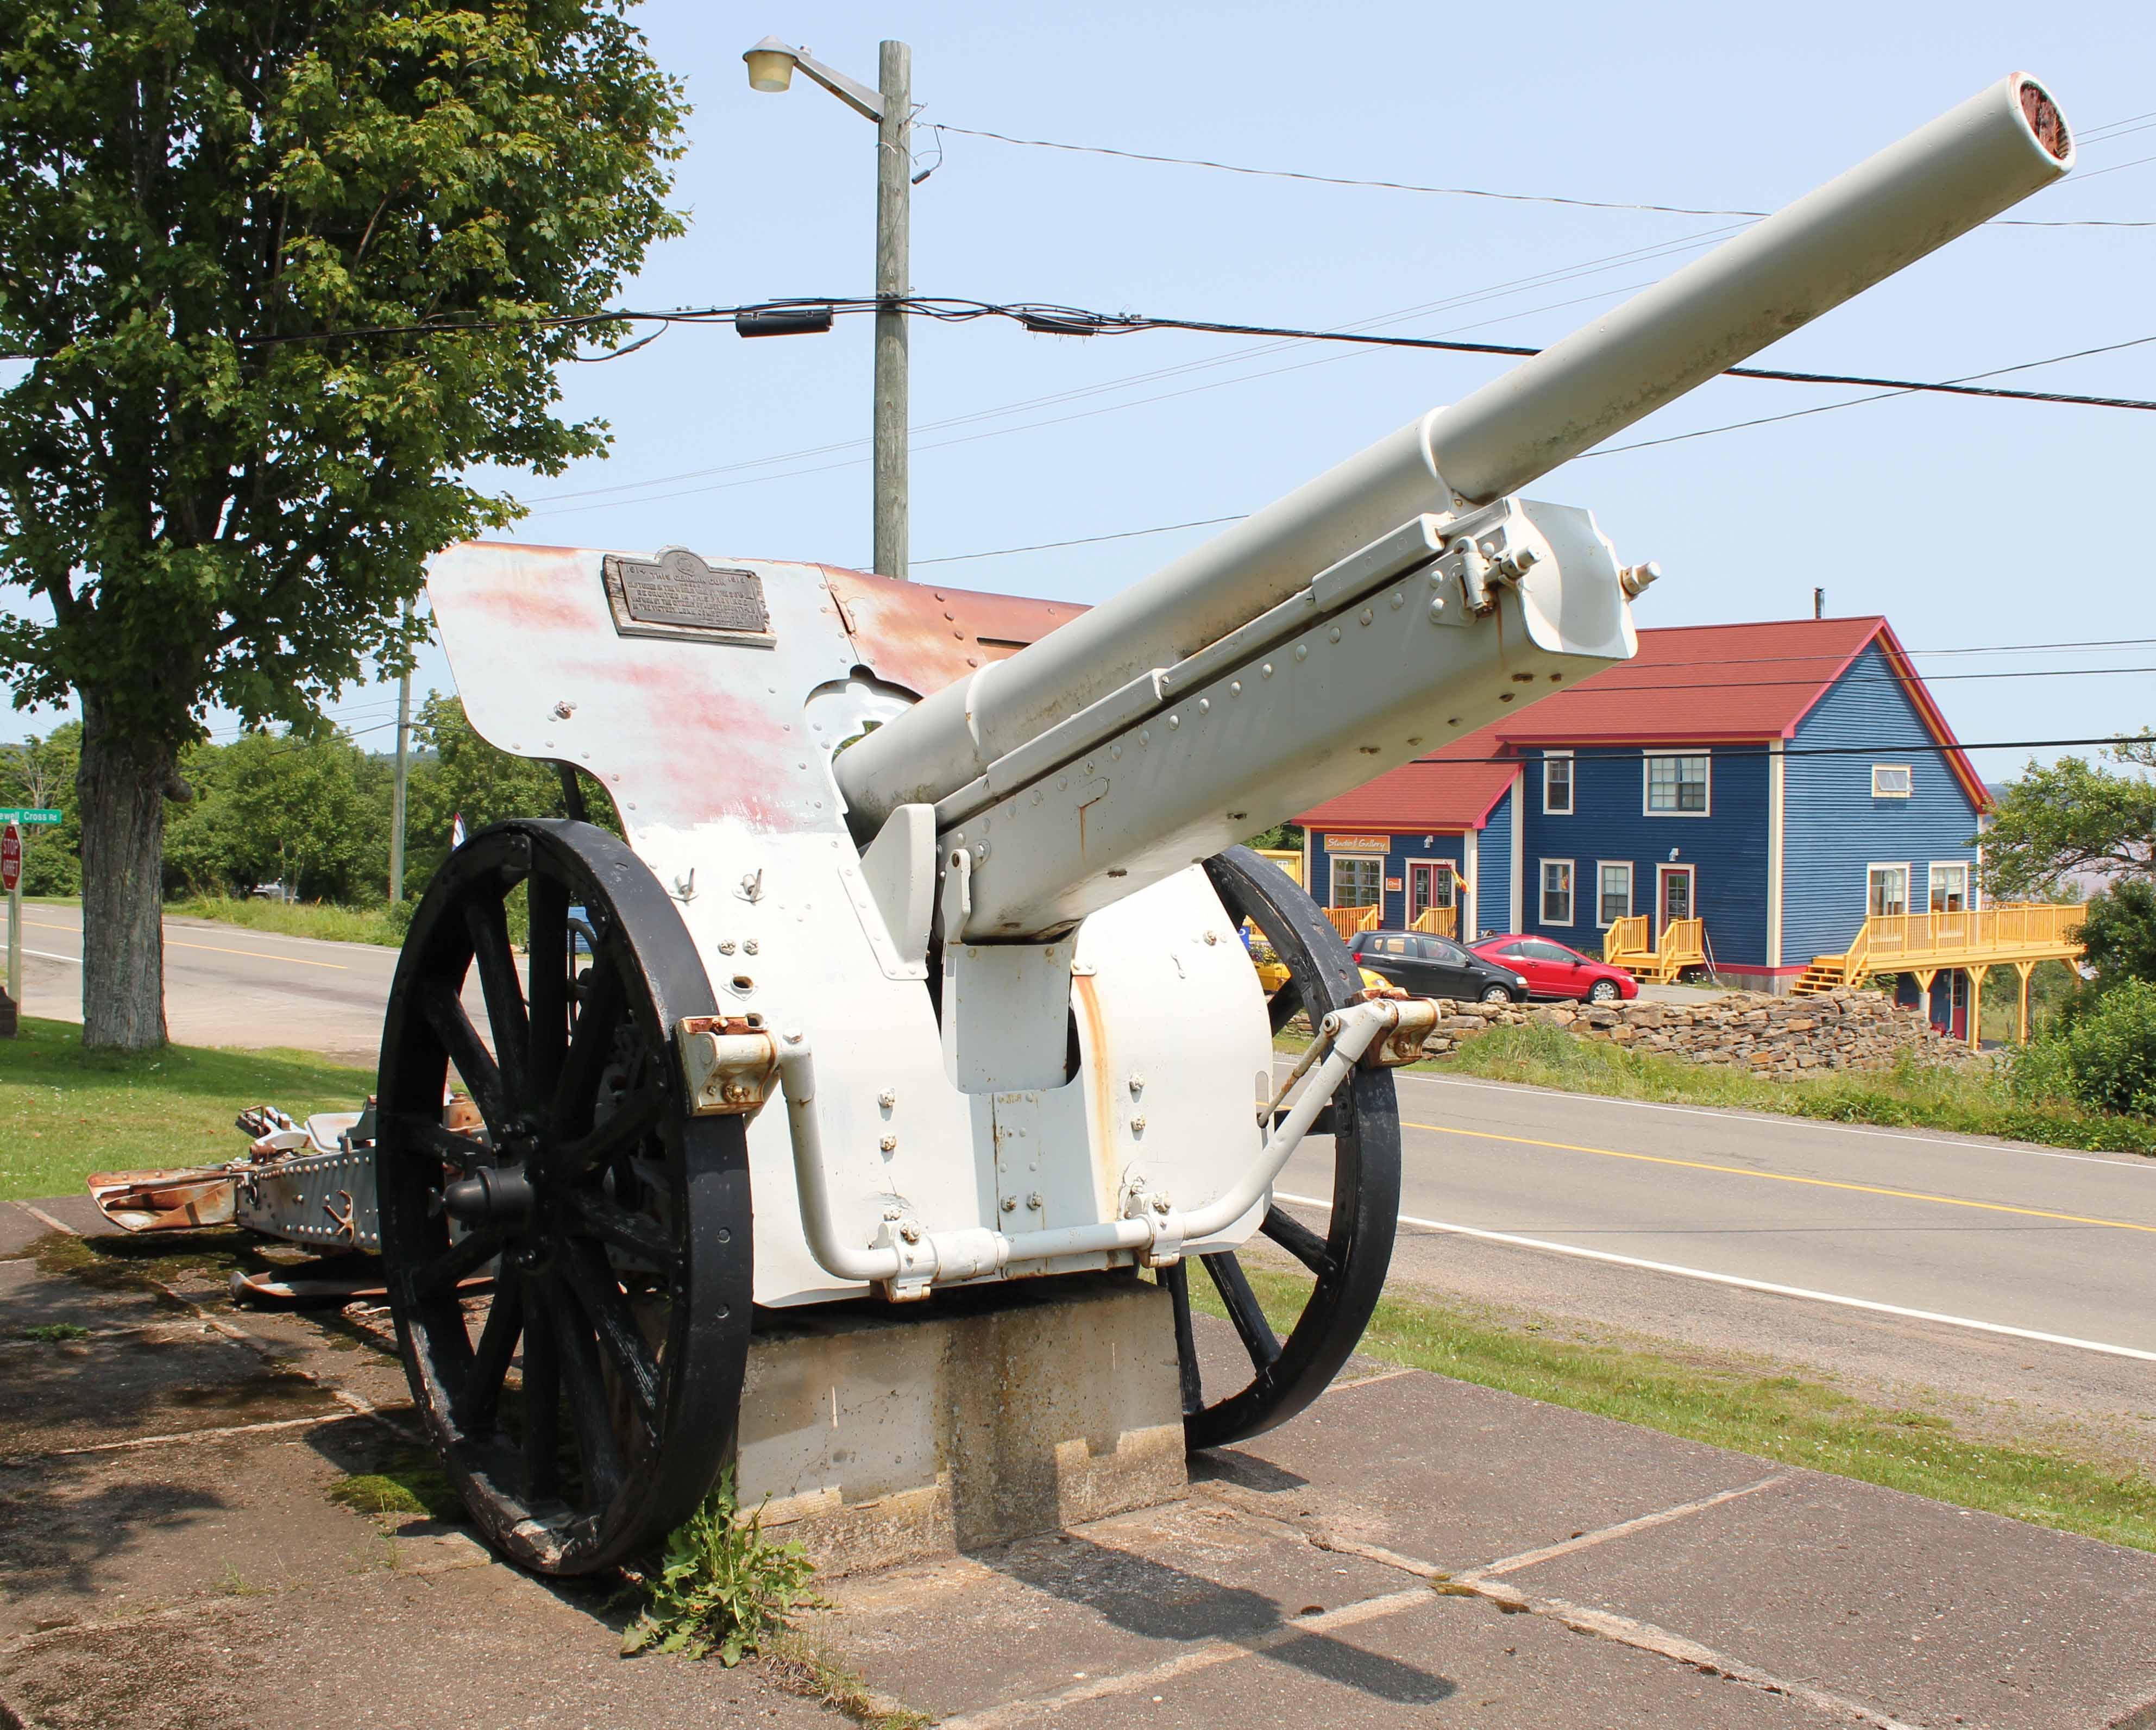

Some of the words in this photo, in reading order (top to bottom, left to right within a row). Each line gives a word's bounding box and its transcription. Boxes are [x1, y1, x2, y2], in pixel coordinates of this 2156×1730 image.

[625, 565, 646, 575] 1914
[649, 571, 671, 581] THIS
[672, 574, 707, 584] GERMAN
[707, 577, 726, 587] GUN
[636, 589, 679, 599] RECRUITED
[24, 811, 47, 821] Cross
[4, 838, 18, 855] STOP
[1328, 838, 1353, 847] Studio
[1359, 839, 1385, 851] Gallery
